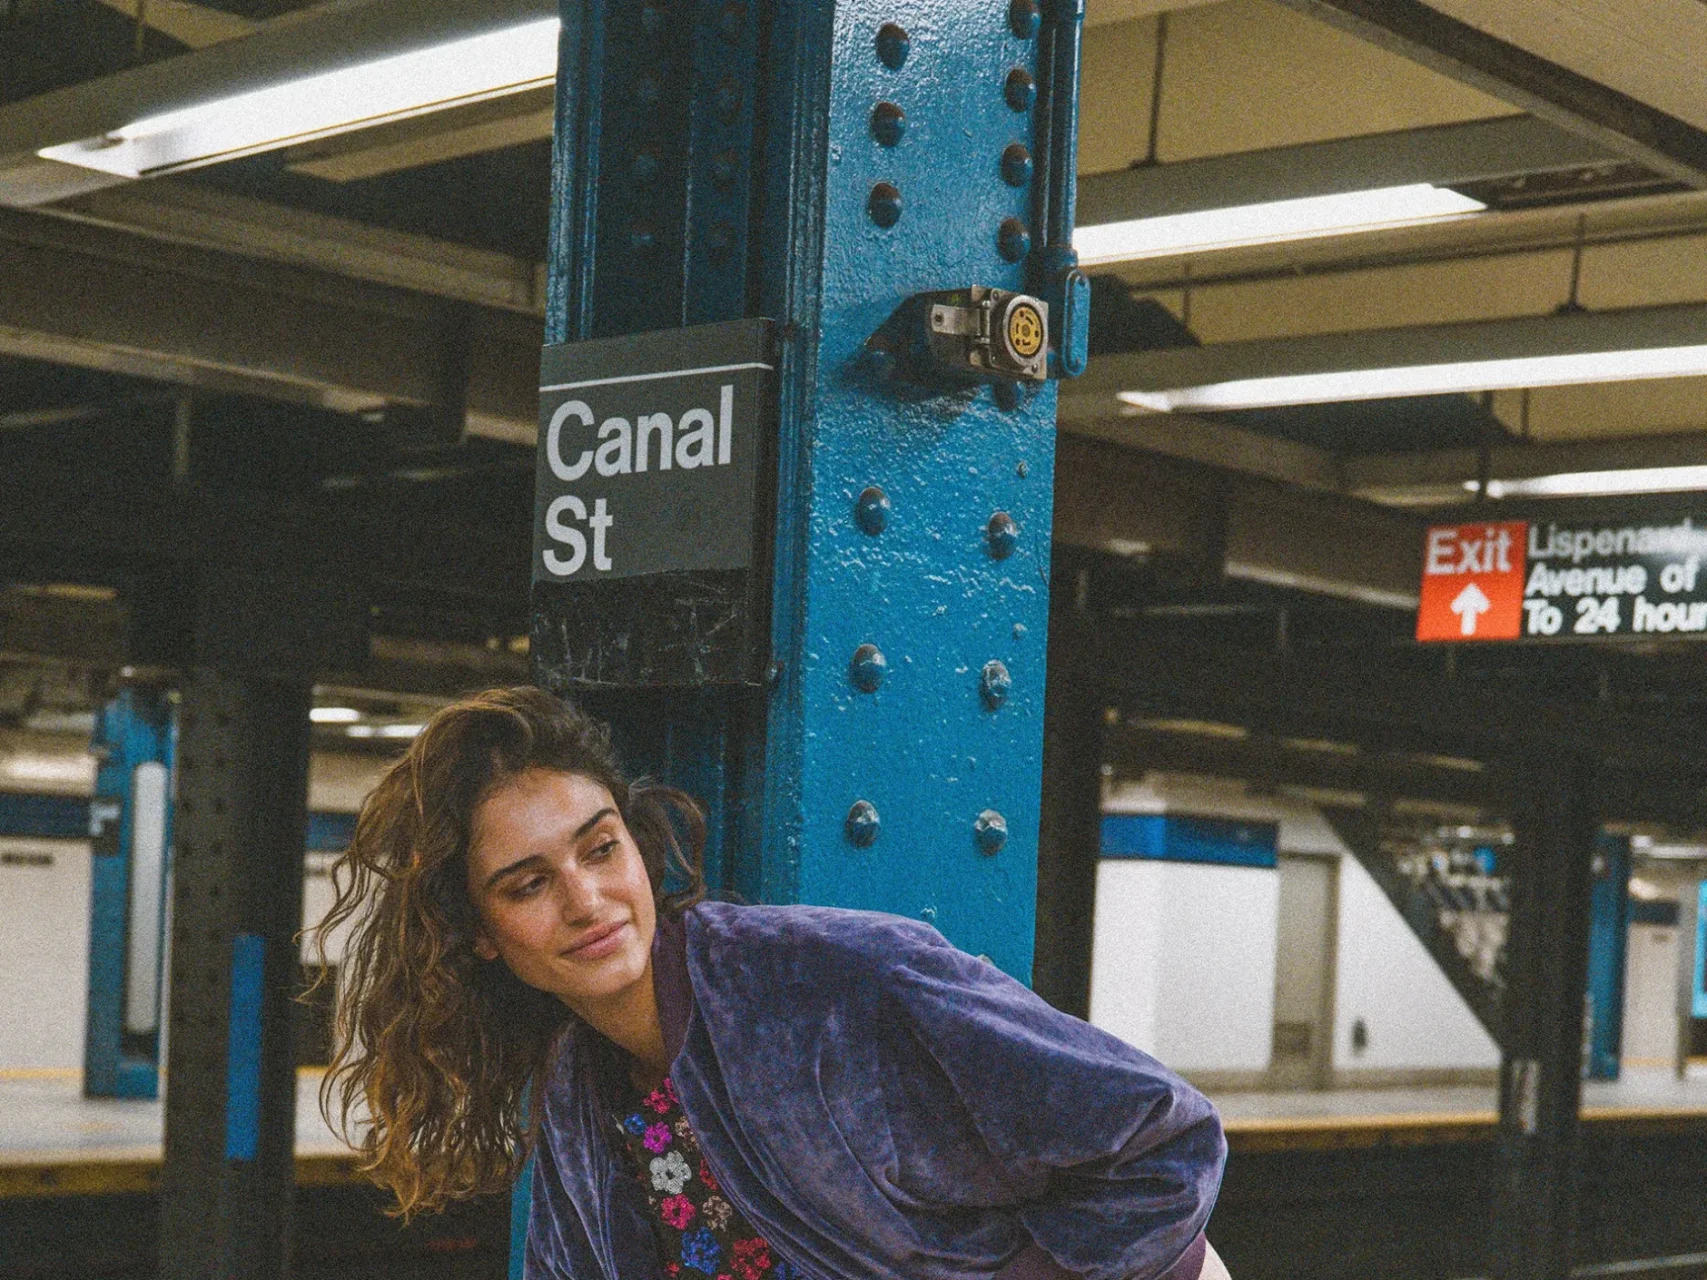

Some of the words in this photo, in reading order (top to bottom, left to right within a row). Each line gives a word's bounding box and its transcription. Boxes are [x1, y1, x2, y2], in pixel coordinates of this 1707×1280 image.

[546, 384, 734, 482] Canal
[542, 494, 613, 576] St
[1426, 527, 1512, 576] Exit
[1525, 562, 1648, 597] Avenue
[1660, 556, 1699, 594] of
[1523, 599, 1563, 635] To
[1574, 596, 1621, 634] 24
